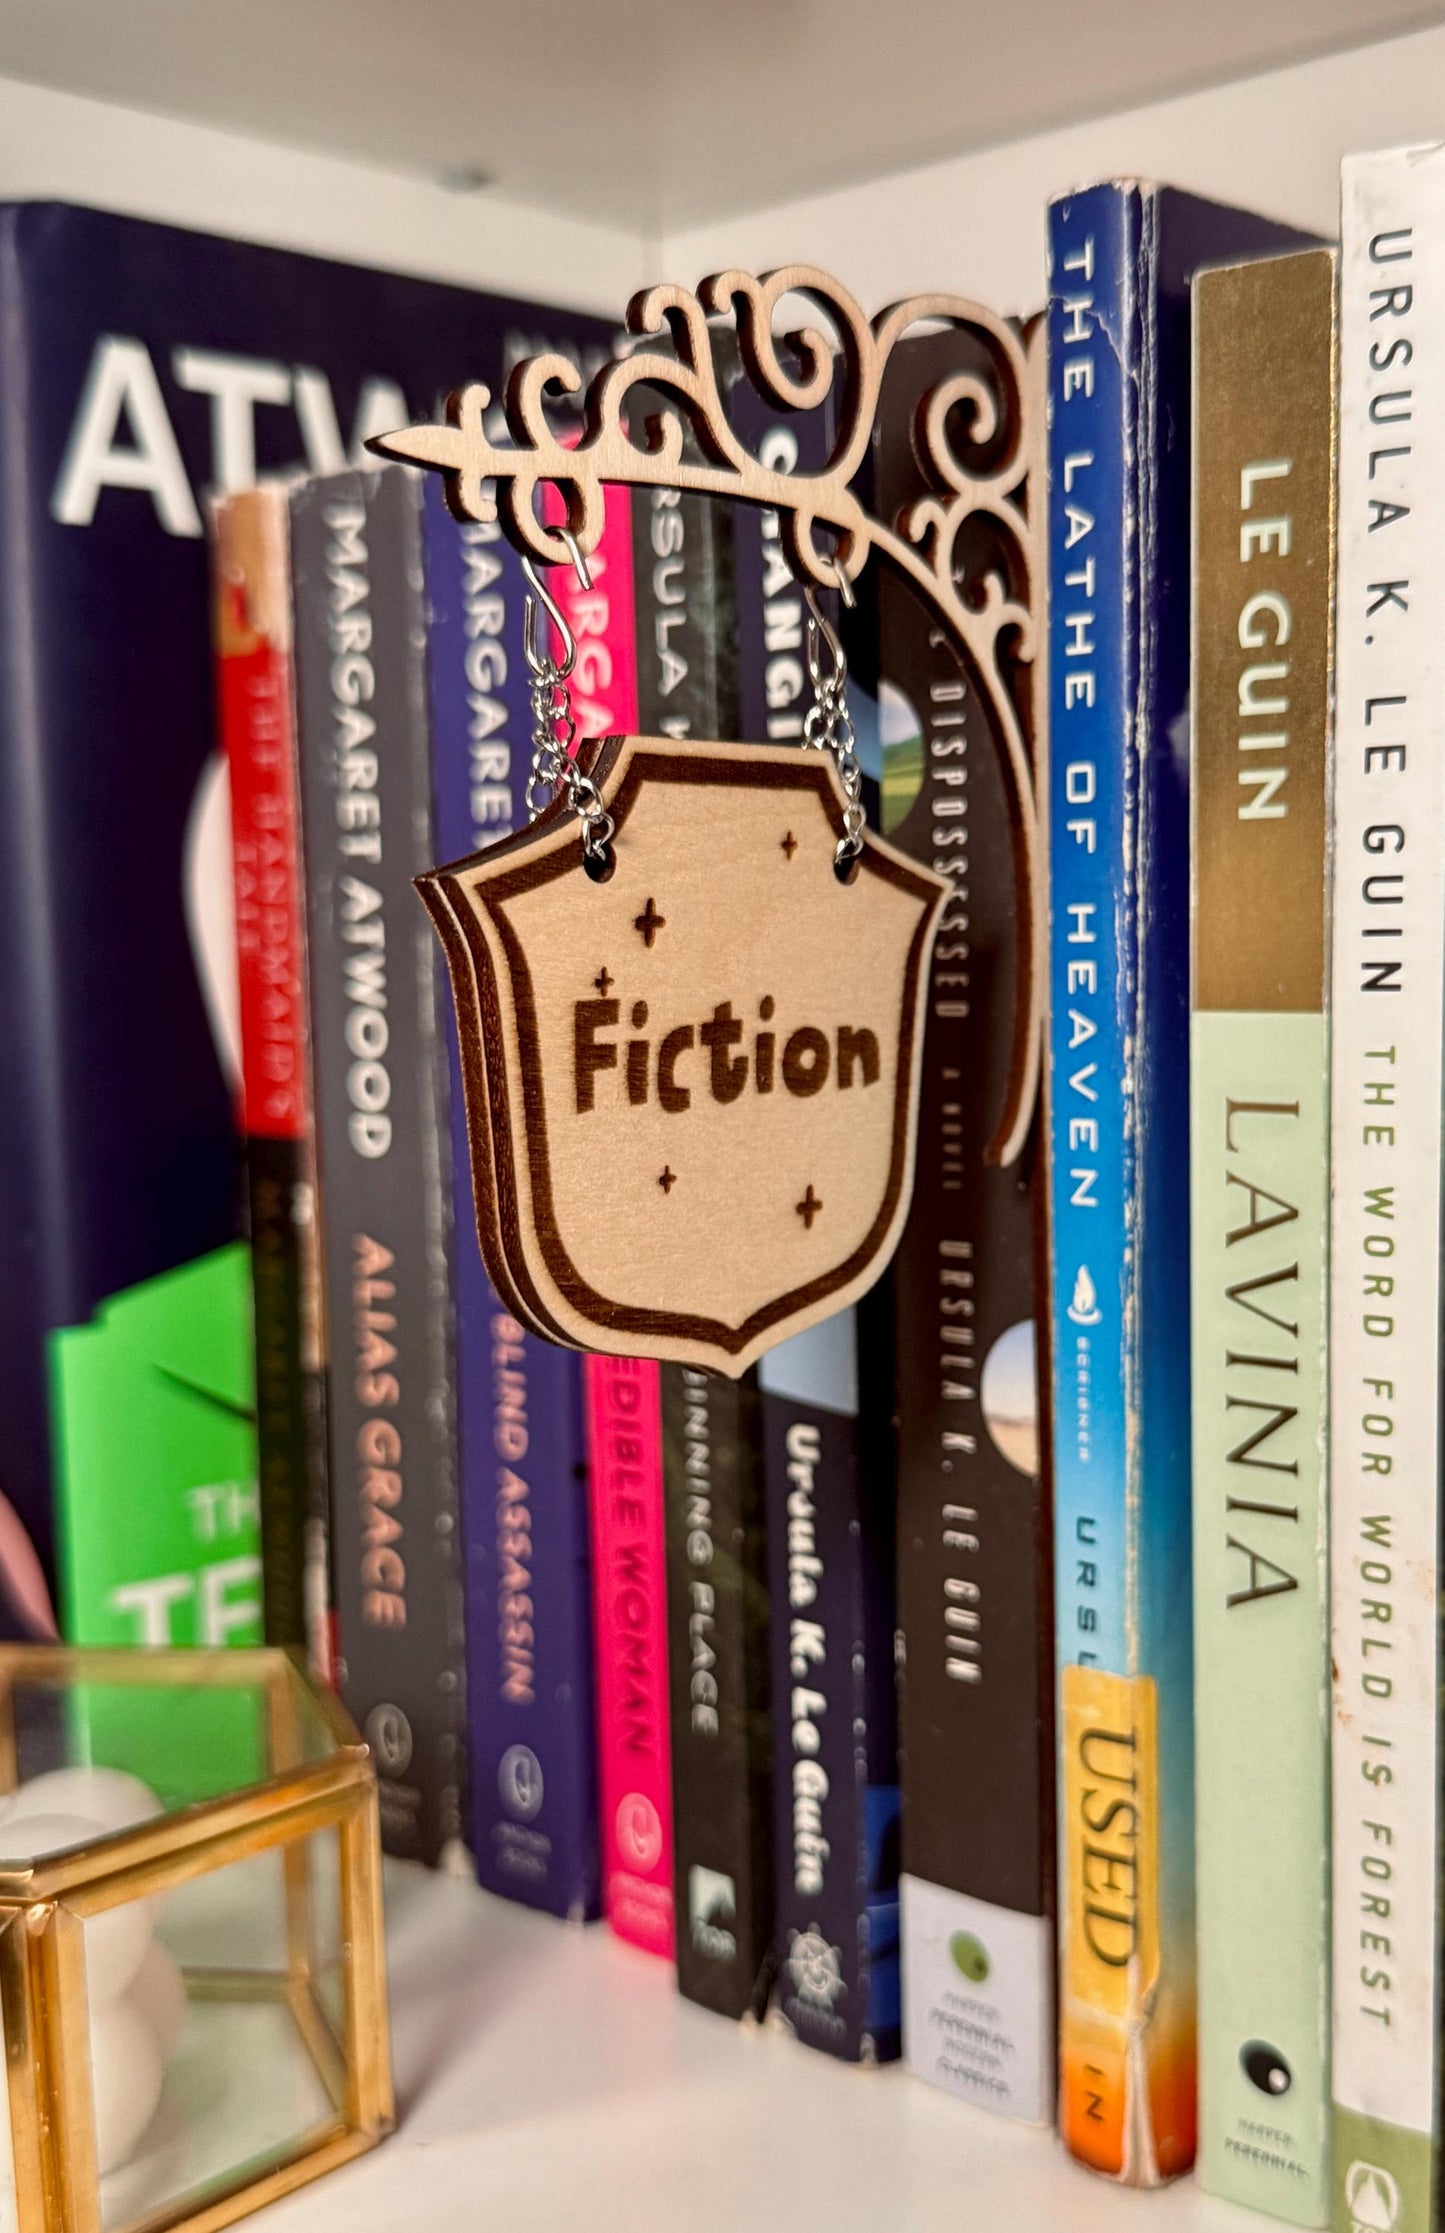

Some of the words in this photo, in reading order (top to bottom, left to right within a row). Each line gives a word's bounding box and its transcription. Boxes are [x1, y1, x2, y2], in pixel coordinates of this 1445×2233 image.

[1063, 238, 1094, 402] THE
[1366, 227, 1414, 534] URSULA
[1064, 452, 1096, 710] LATHE
[1239, 463, 1292, 562] LE
[322, 505, 382, 864] MARGARET
[1364, 579, 1409, 646] K.
[1066, 761, 1097, 854] OF
[1363, 696, 1407, 774] LE
[1360, 821, 1404, 992] GUIN
[341, 874, 392, 1159] ATWOOD
[574, 994, 881, 1114] Fiction
[1066, 903, 1098, 1208] HEAVEN
[1362, 1045, 1396, 1146] THE
[351, 1232, 400, 1409] ALIAS
[939, 1240, 976, 1399] URSULA
[1362, 1186, 1395, 1338] WORD
[490, 1312, 529, 1462] BLIND
[1225, 1097, 1301, 1610] LAVINIA
[1361, 1378, 1394, 1475] FOR
[357, 1417, 407, 1628] GRACE
[786, 1424, 823, 1609] Ursula
[940, 1431, 977, 1473] K.
[942, 1502, 980, 1553] LE
[496, 1466, 536, 1706] ASSASSIN
[614, 1543, 650, 1754] WOMAN
[689, 1581, 719, 1738] PLACE
[790, 1619, 826, 1679] K.
[943, 1577, 982, 1684] GUIN
[1361, 1514, 1393, 1700] WORLD
[792, 1686, 827, 1755] Le
[1361, 1735, 1393, 1784] IS
[793, 1759, 830, 1895] Guin
[1079, 1726, 1138, 1968] USED
[1359, 1819, 1394, 2028] FOREST
